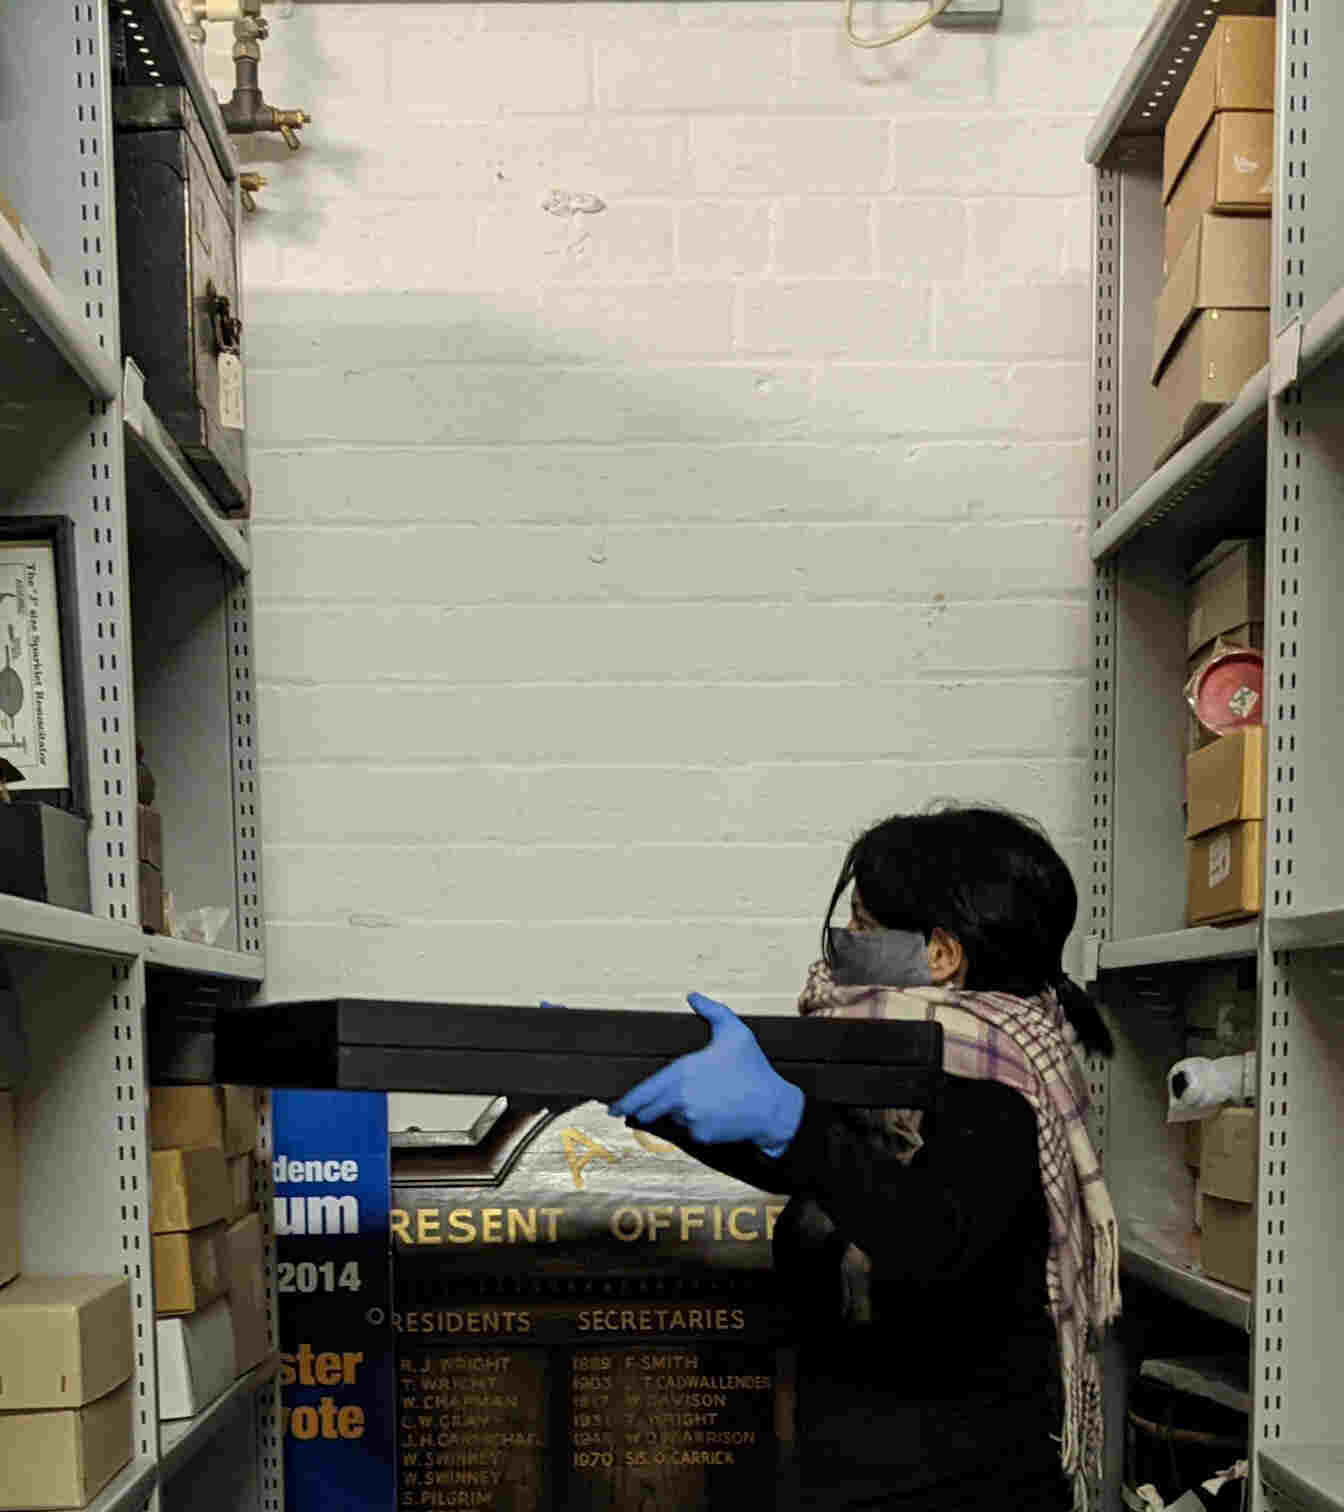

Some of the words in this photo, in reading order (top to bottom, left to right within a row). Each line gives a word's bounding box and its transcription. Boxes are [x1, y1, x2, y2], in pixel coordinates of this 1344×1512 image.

[277, 1261, 361, 1293] 2014
[577, 1307, 744, 1332] SECRETARIES
[639, 1355, 699, 1371] SMITH
[280, 1397, 366, 1441] ote
